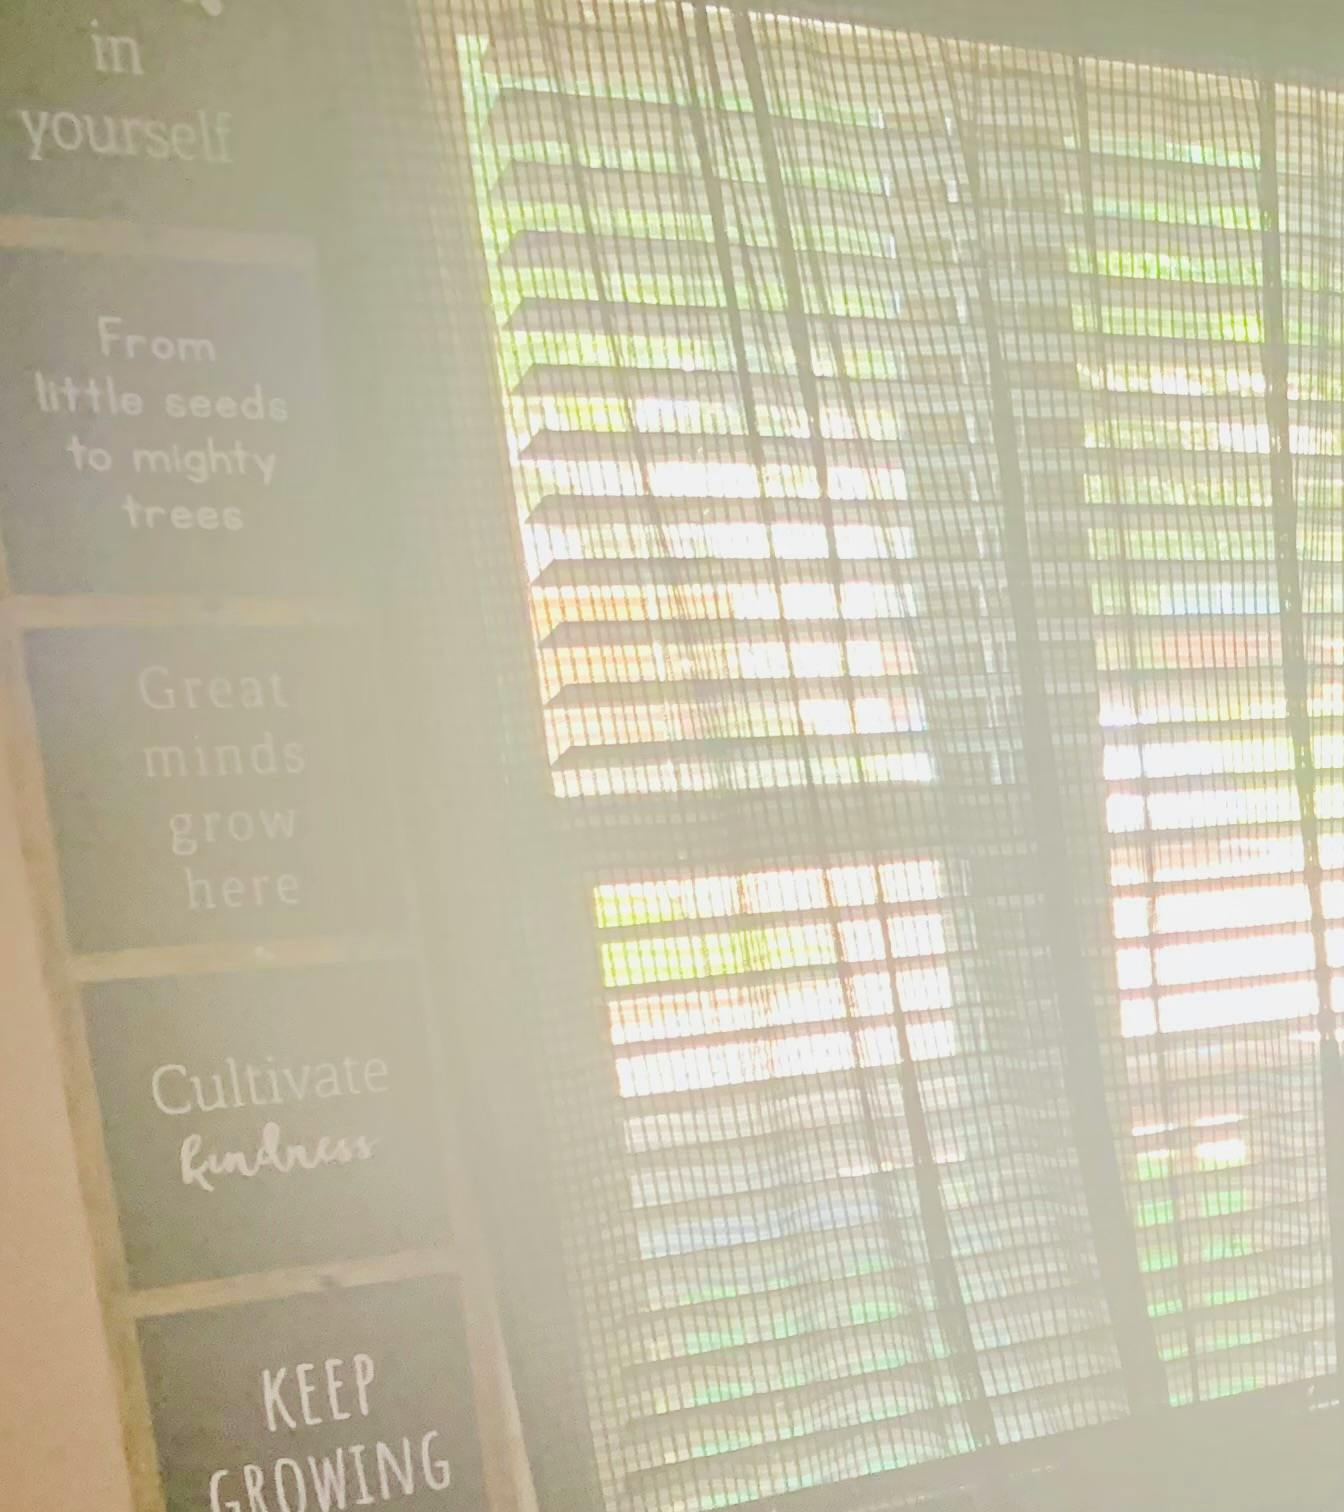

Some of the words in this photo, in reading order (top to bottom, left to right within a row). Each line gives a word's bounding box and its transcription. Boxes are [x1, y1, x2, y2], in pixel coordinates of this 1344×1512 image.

[90, 18, 144, 75] in
[17, 109, 232, 163] yourself
[98, 315, 216, 362] From
[35, 369, 143, 417] little
[165, 382, 289, 423] seeds
[66, 434, 112, 472] to
[132, 436, 277, 485] mighty
[121, 493, 244, 531] trees
[137, 665, 289, 710] Great
[142, 731, 305, 778] minds
[169, 808, 296, 855] grow
[183, 866, 302, 911] here
[151, 1054, 389, 1116] Cultivate
[180, 1122, 380, 1192] kindness
[262, 1352, 376, 1433] KEEP
